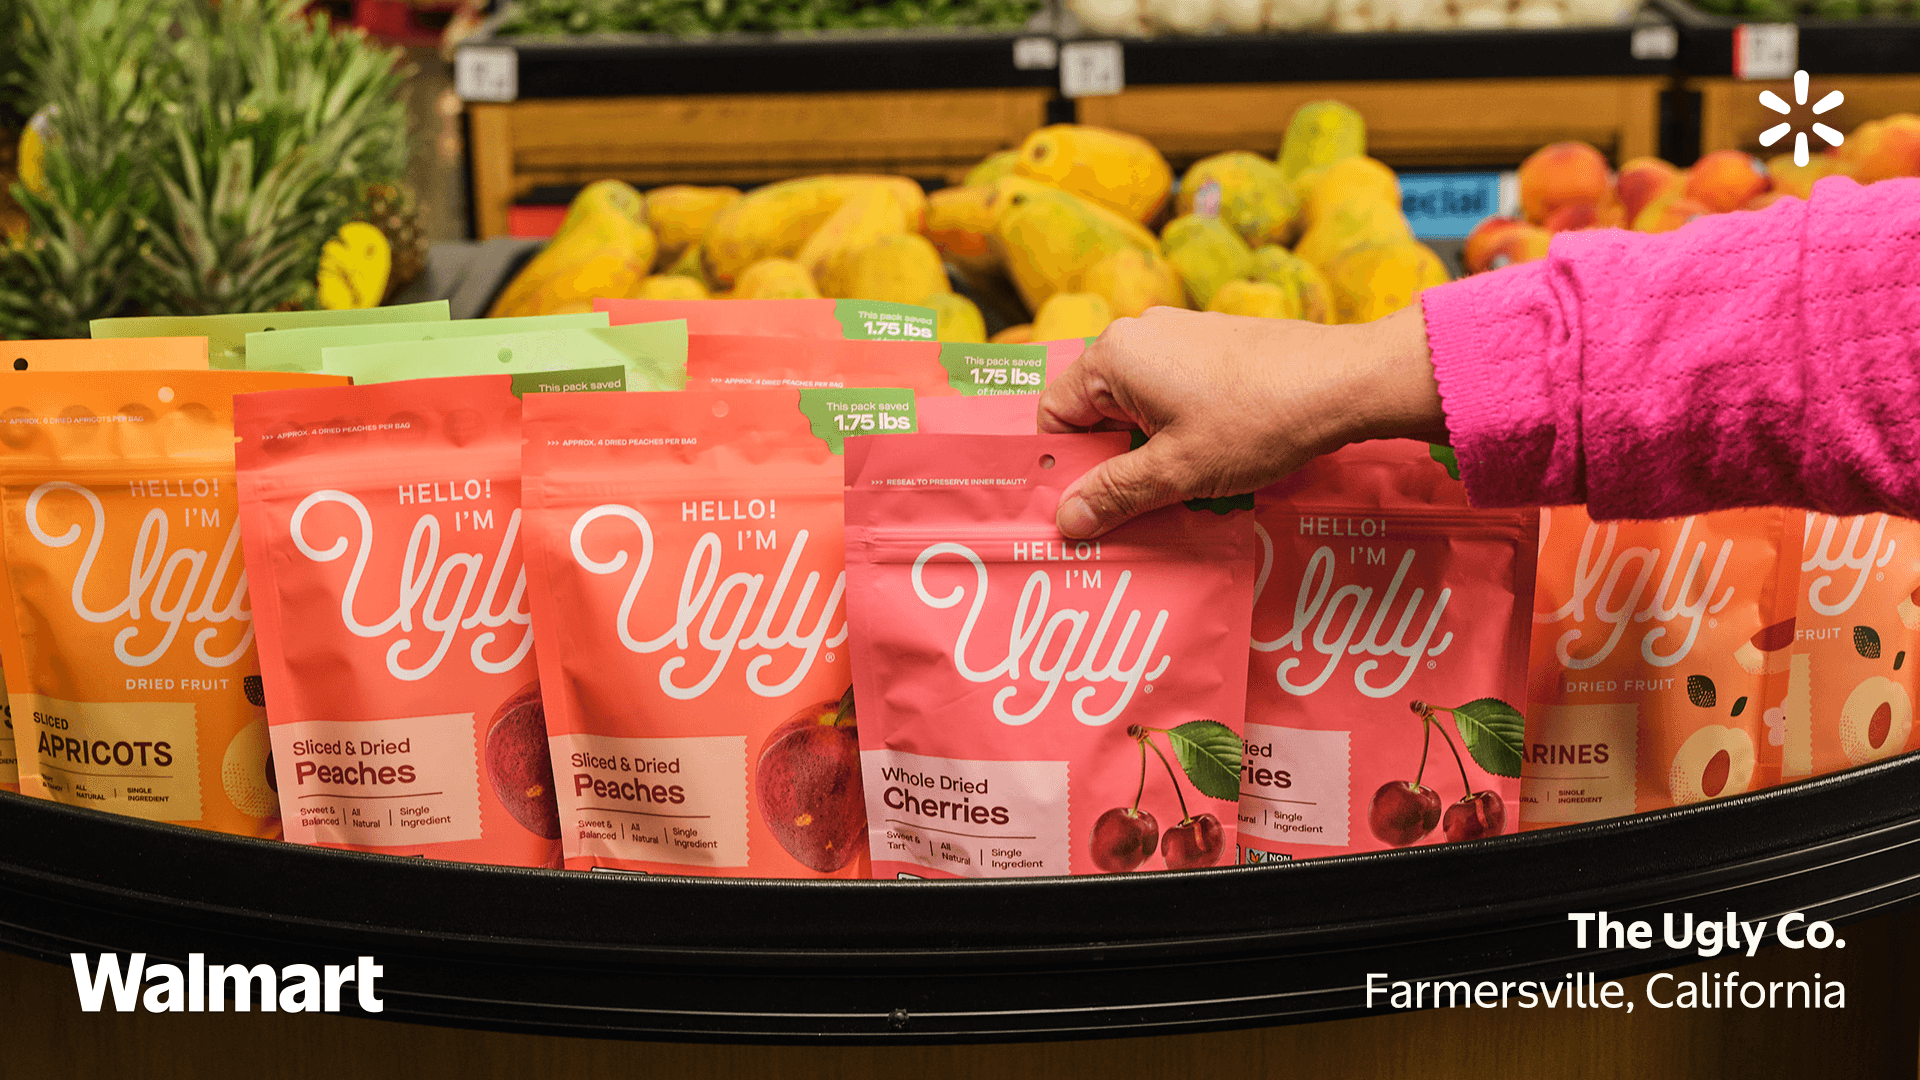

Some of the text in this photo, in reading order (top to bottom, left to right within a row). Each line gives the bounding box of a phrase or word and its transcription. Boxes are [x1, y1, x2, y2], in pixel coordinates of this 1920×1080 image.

[864, 321, 933, 338] 1.75 lbs
[964, 356, 1041, 367] This pack saved
[970, 368, 1041, 385] 1.75 lbs
[538, 379, 621, 392] This pack saved
[826, 401, 909, 413] This pack saved
[834, 412, 911, 431] 1.75 lbs
[318, 427, 341, 435] DRIED
[342, 424, 377, 433] PEACHES
[605, 438, 627, 446] DRIED
[629, 438, 664, 446] PEACHES
[665, 437, 680, 445] PER
[681, 437, 697, 445] BAG
[129, 478, 219, 498] HELLO!
[929, 478, 969, 486] PRESERVE
[398, 479, 492, 505] HELLO!
[682, 499, 776, 522] HELLO!
[185, 508, 220, 528] I'M
[455, 509, 494, 532] I'M
[1300, 517, 1387, 538] HELLO!
[737, 529, 777, 551] I'M
[1013, 541, 1101, 561] HELLO!
[1350, 546, 1386, 566] I'M
[1065, 570, 1101, 589] I'M
[570, 504, 848, 700] Ugly
[911, 542, 1171, 726] Ugly
[1796, 626, 1841, 642] FRUIT
[126, 678, 229, 691] DRIED FRUIT
[1566, 678, 1674, 693] DRIED FRUIT
[33, 711, 69, 730] SLICED
[38, 731, 174, 767] APRICOTS
[293, 737, 411, 756] Sliced & Dried
[571, 752, 680, 773] Sliced & Dried
[295, 760, 416, 785] Peaches
[881, 767, 988, 794] Whole Dried
[76, 784, 87, 792] ALL
[573, 773, 686, 804] Peaches
[76, 791, 106, 801] NATURAL
[127, 795, 169, 803] INGREDIENT
[1558, 796, 1603, 804] INGREDIENT
[300, 806, 336, 816] Sweet &
[351, 807, 361, 816] All
[399, 805, 430, 817] Single
[883, 786, 1010, 825] Cherries
[301, 816, 340, 827] Balanced
[400, 814, 451, 828] Ingredient
[1274, 810, 1303, 821] Single
[352, 818, 381, 828] Natural
[578, 819, 613, 829] Sweet &
[631, 823, 641, 832] All
[1273, 821, 1323, 834] Ingredient
[579, 829, 617, 840] Balanced
[632, 833, 659, 844] Natural
[672, 827, 698, 838] Single
[886, 830, 921, 844] Sweet &
[674, 839, 718, 849] Ingredient
[887, 842, 907, 850] Tart
[940, 841, 951, 851] All
[942, 852, 971, 866] Natural
[991, 848, 1022, 860] Single
[991, 859, 1043, 872] Ingredient
